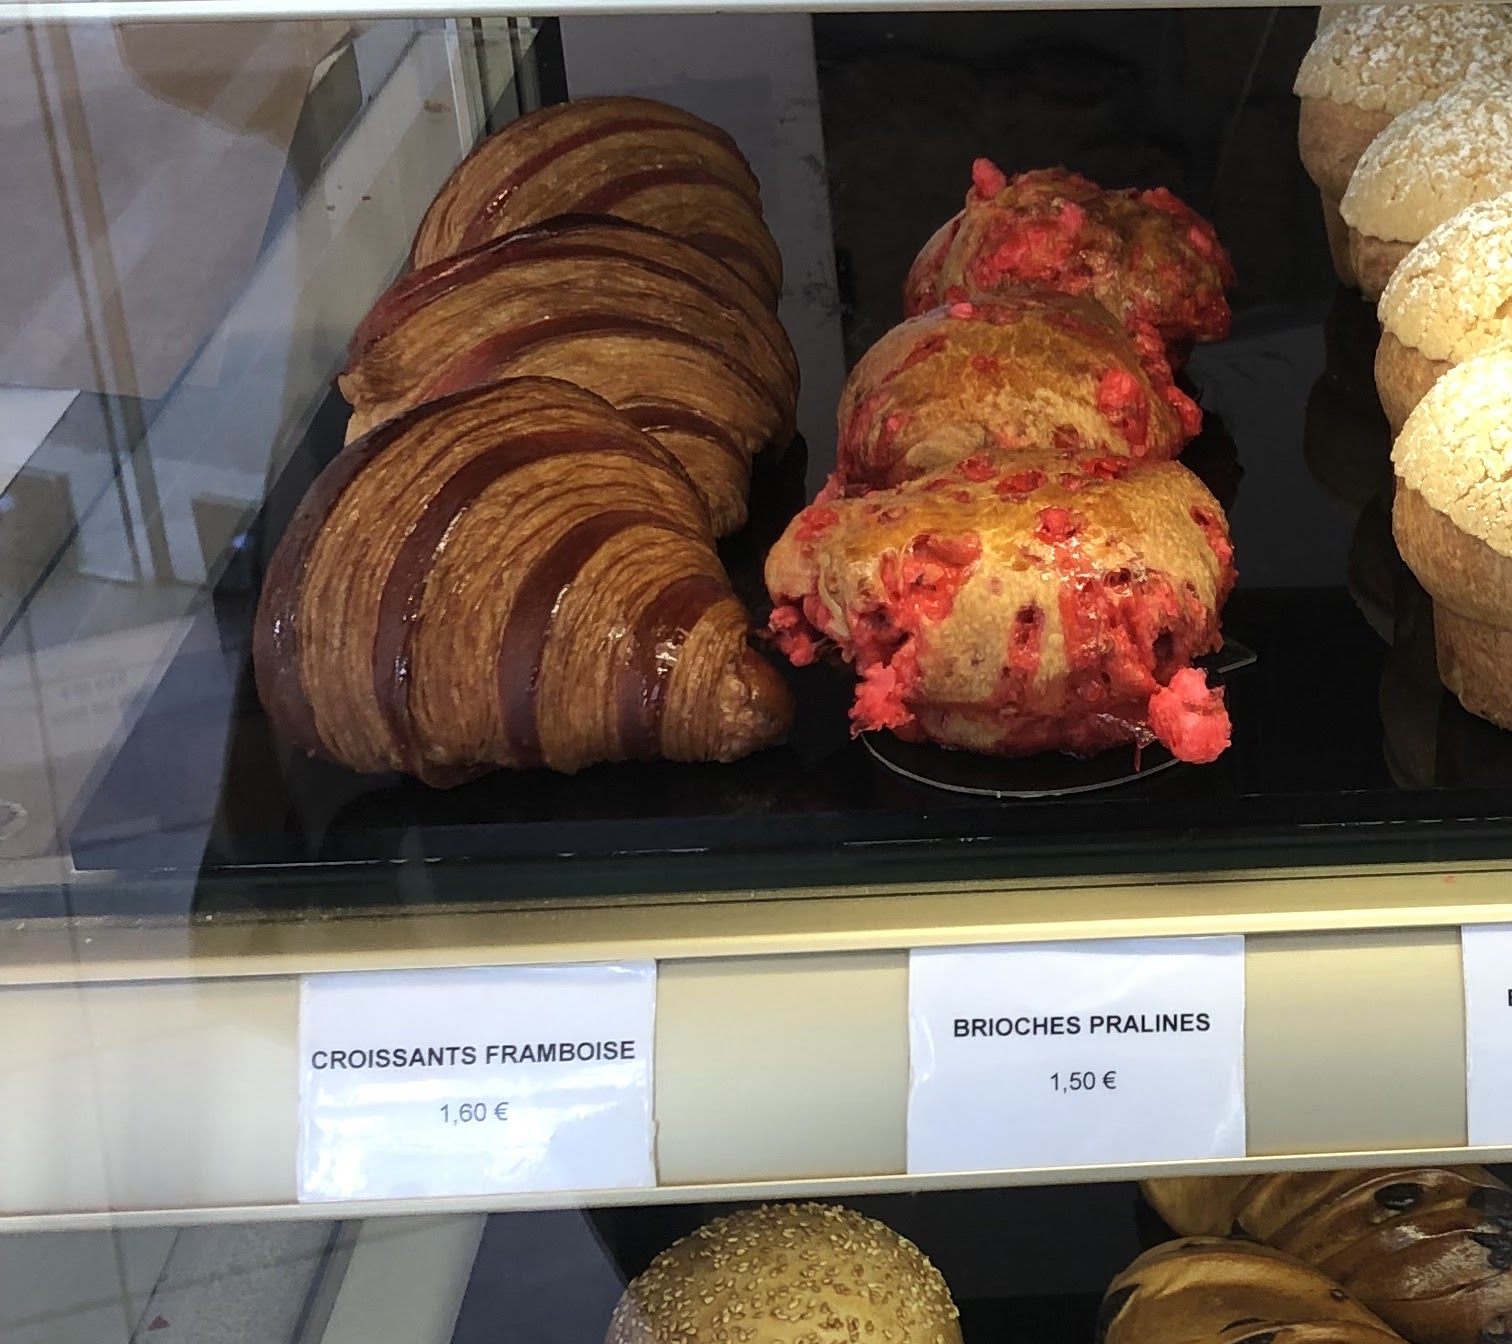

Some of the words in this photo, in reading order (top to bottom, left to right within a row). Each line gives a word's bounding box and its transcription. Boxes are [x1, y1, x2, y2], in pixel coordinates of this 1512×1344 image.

[953, 1015, 1081, 1038] BRIOCHES
[1090, 1012, 1211, 1035] PRALINES
[311, 1045, 477, 1070] CROISSANTS
[485, 1040, 636, 1065] FRAMBOISE
[1050, 1071, 1096, 1094] 1,50
[1102, 1070, 1117, 1090] €
[440, 1102, 487, 1126] 1,60
[493, 1101, 509, 1122] €
